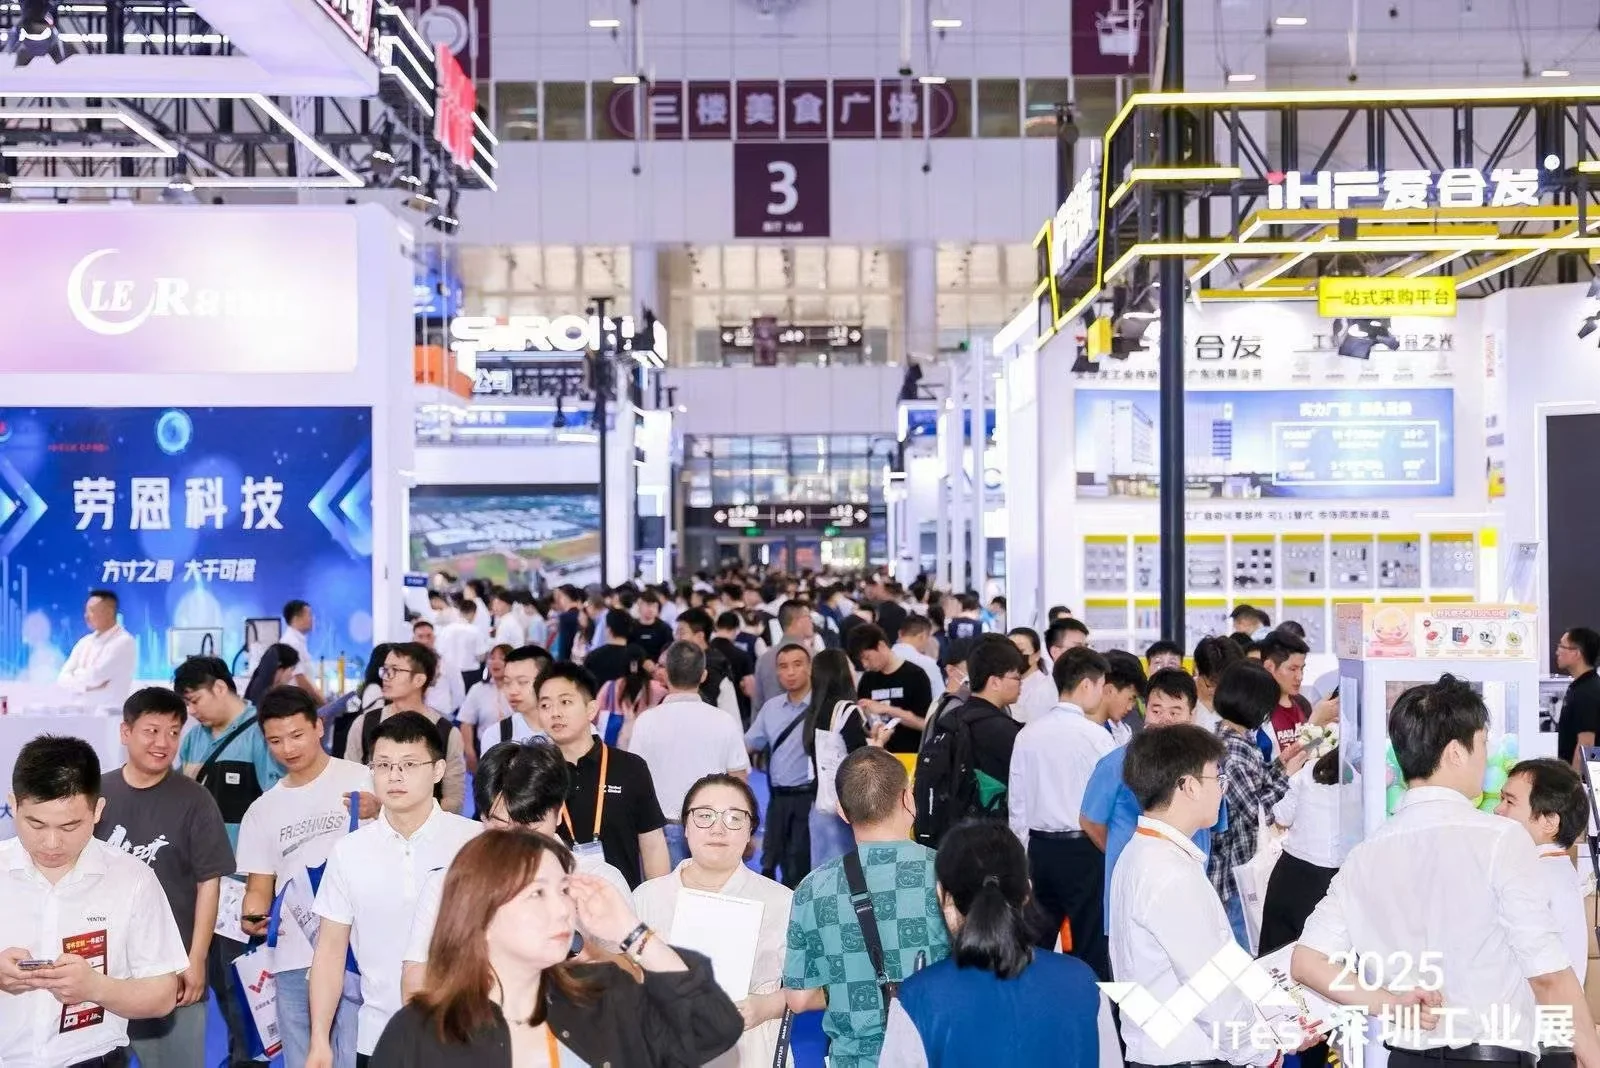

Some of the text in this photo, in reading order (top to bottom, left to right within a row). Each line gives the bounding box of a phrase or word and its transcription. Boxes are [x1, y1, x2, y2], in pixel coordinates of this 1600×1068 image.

[651, 92, 919, 125] 三楼美食广场
[766, 160, 799, 215] 3
[1325, 289, 1450, 306] 一站式采购平台
[73, 476, 285, 530] 劳恩科技
